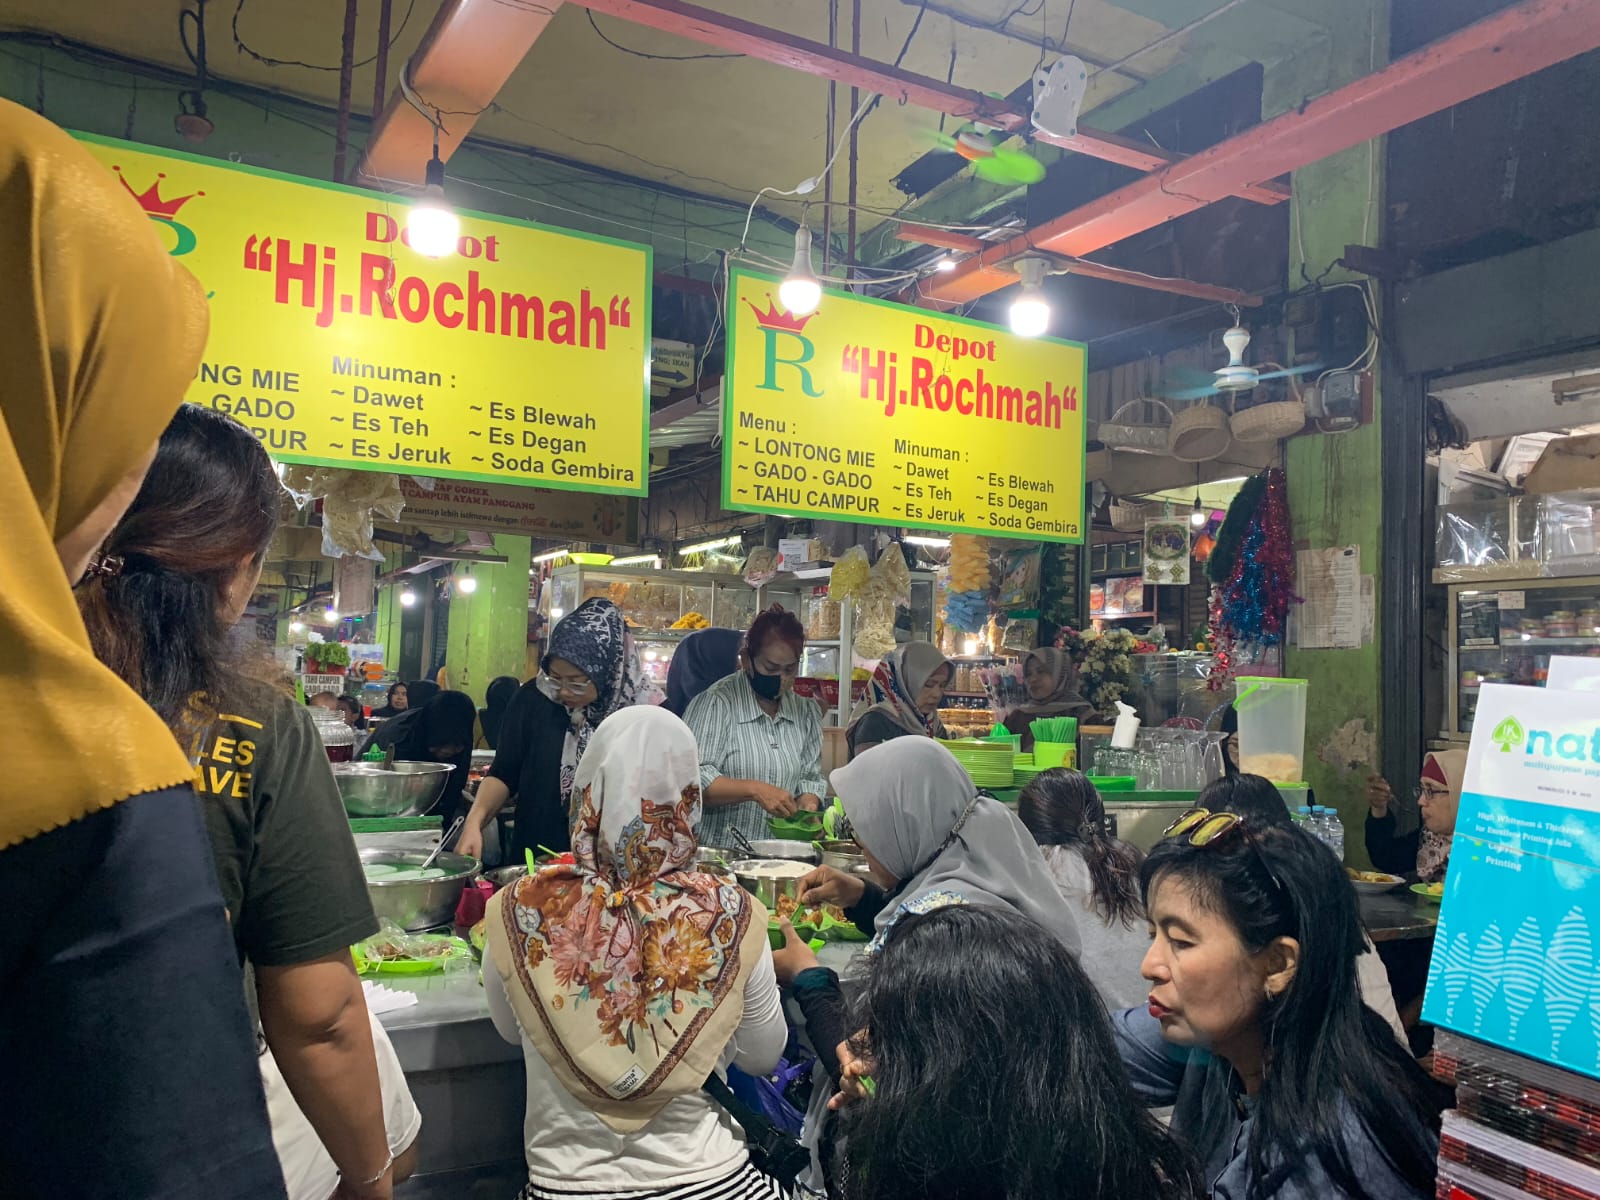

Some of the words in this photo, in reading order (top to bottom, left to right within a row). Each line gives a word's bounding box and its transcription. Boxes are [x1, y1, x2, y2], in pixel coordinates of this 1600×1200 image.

[366, 212, 499, 262] Dot
[914, 323, 996, 362] Depot
[332, 355, 442, 387] Minuman
[755, 325, 825, 398] R
[252, 368, 300, 393] MIE
[211, 393, 295, 421] GADO
[353, 386, 424, 411] Dawet
[353, 412, 381, 432] Es
[389, 416, 429, 437] Teh
[490, 401, 516, 421] Es
[523, 405, 596, 430] Blewah
[739, 411, 786, 434] Menu
[352, 438, 380, 458] Es
[388, 442, 451, 466] Jeruk
[489, 426, 515, 446] Es
[522, 430, 586, 456] Degan
[754, 437, 842, 464] LONTONG
[846, 450, 876, 469] MIE
[894, 438, 961, 462] Minuman
[491, 452, 544, 474] Soda
[551, 458, 634, 483] Gembira
[754, 460, 808, 482] GADO
[822, 470, 873, 490] GADO
[906, 461, 950, 481] Dawet
[905, 482, 924, 499] Es
[927, 485, 953, 502] Teh
[988, 471, 1005, 488] Es
[1008, 474, 1055, 494] Blewah
[408, 489, 450, 501] CAMPUR
[453, 494, 481, 505] AYAM
[482, 498, 536, 511] PANGGANG
[752, 484, 801, 506] TAHU
[806, 490, 880, 514] CAMPUR
[988, 491, 1005, 507] Es
[1008, 494, 1049, 515] Degan
[905, 502, 924, 519] Es
[927, 505, 966, 523] Jeruk
[989, 512, 1023, 530] Soda
[1025, 515, 1078, 535] Gembira
[1522, 832, 1553, 845] Printing
[1485, 856, 1522, 872] Printing
